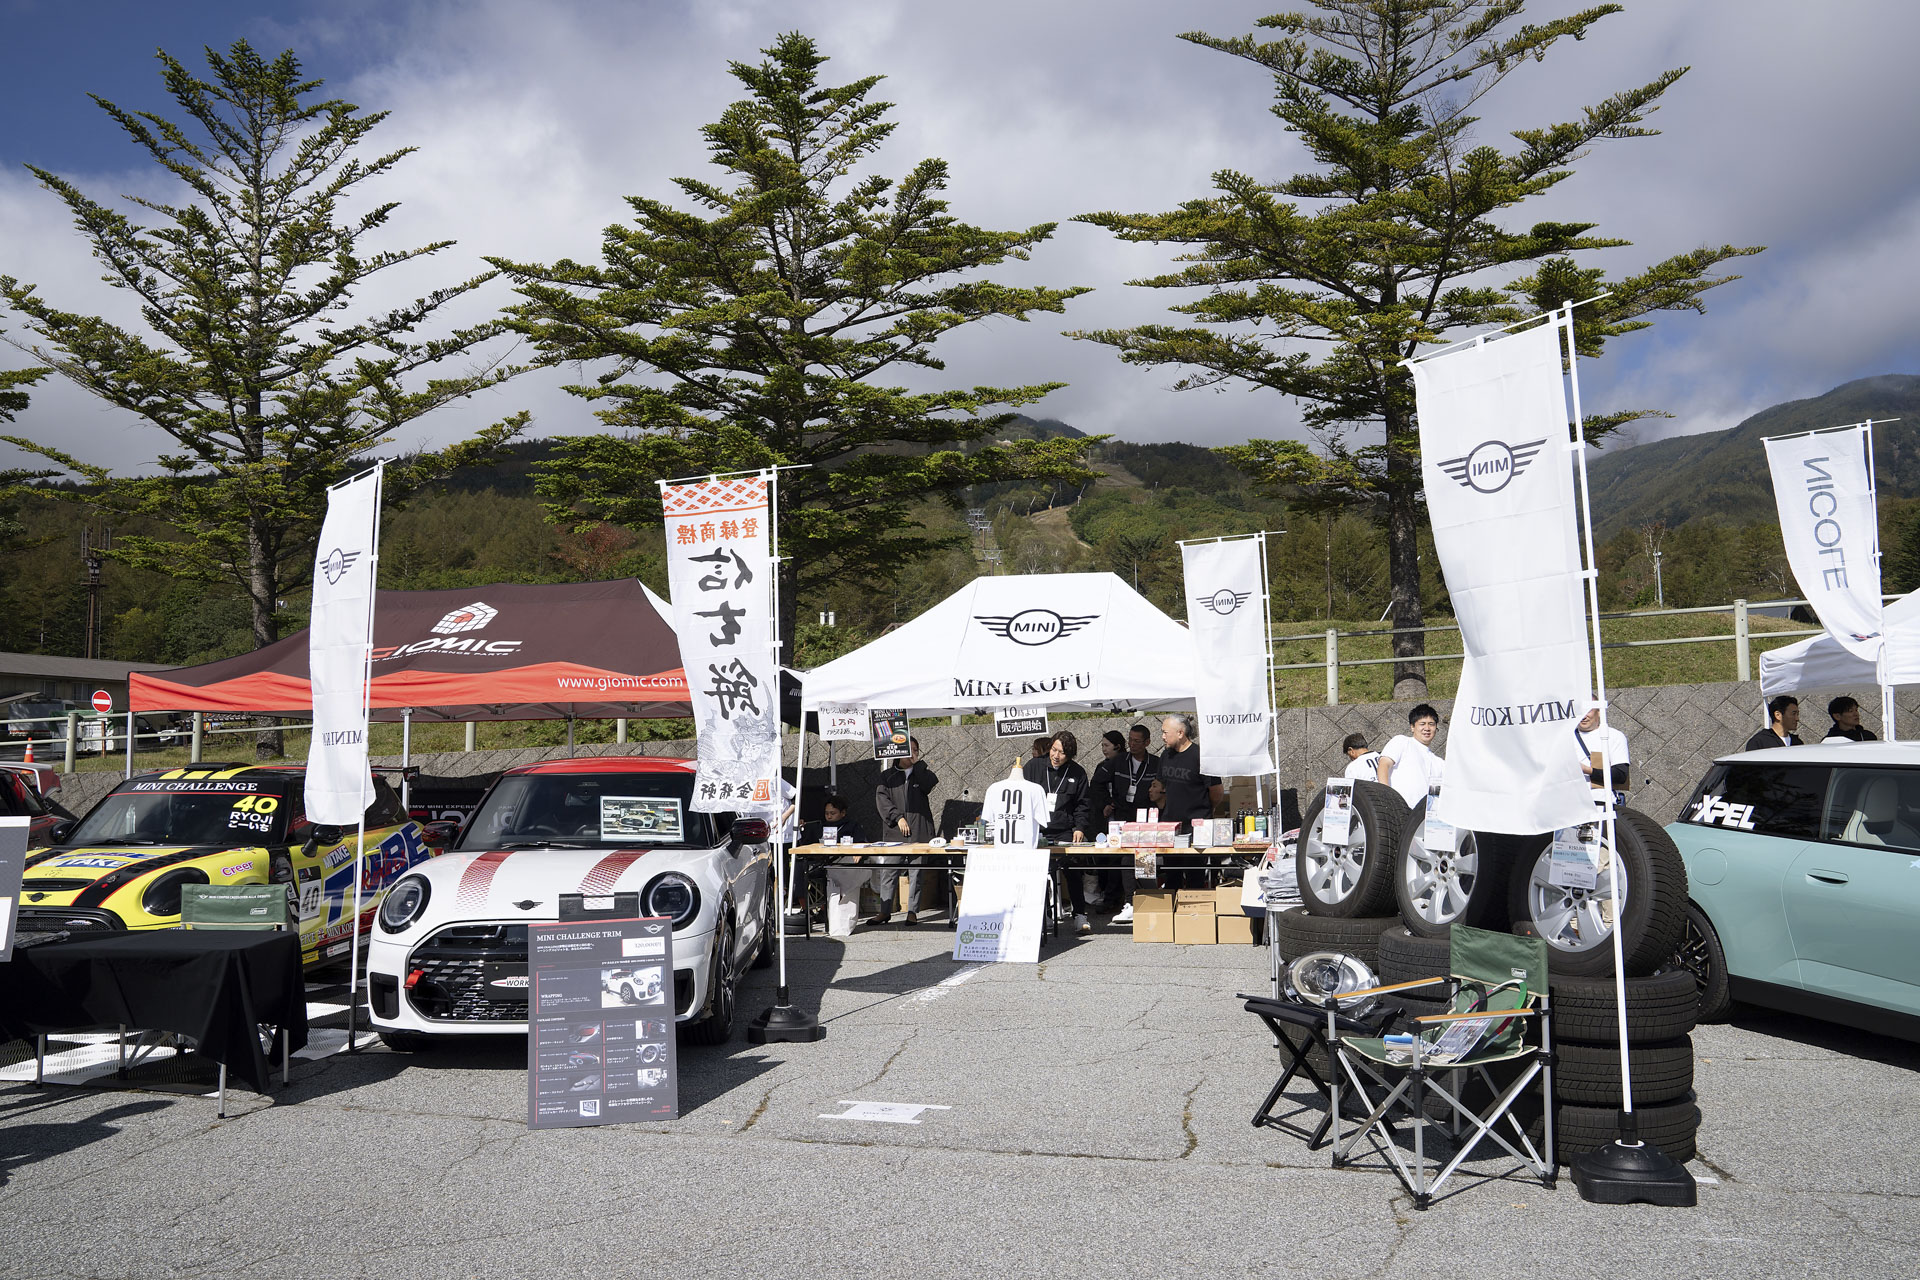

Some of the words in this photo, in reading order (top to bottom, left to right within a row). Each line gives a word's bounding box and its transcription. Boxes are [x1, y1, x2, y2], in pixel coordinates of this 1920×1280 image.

[1014, 622, 1056, 632] MINI
[557, 675, 683, 691] www.giomic.com
[953, 677, 1014, 697] MINI
[1020, 671, 1091, 695] KOFU
[1001, 719, 1042, 734] 販売開始
[131, 782, 166, 791] MINI
[166, 782, 258, 791] CHALLENGE
[232, 795, 279, 814] 40
[1691, 794, 1756, 830] XPEL
[229, 811, 273, 825] RYOJI
[998, 813, 1026, 821] 3252
[227, 820, 270, 832] こーいち
[323, 844, 350, 869] MITAKE
[220, 860, 254, 877] Creer
[301, 886, 320, 914] 40
[326, 925, 341, 938] MINI
[341, 923, 355, 934] KOF
[536, 934, 555, 942] MINI
[556, 931, 601, 940] CHALLENGE
[602, 930, 622, 938] TRIM
